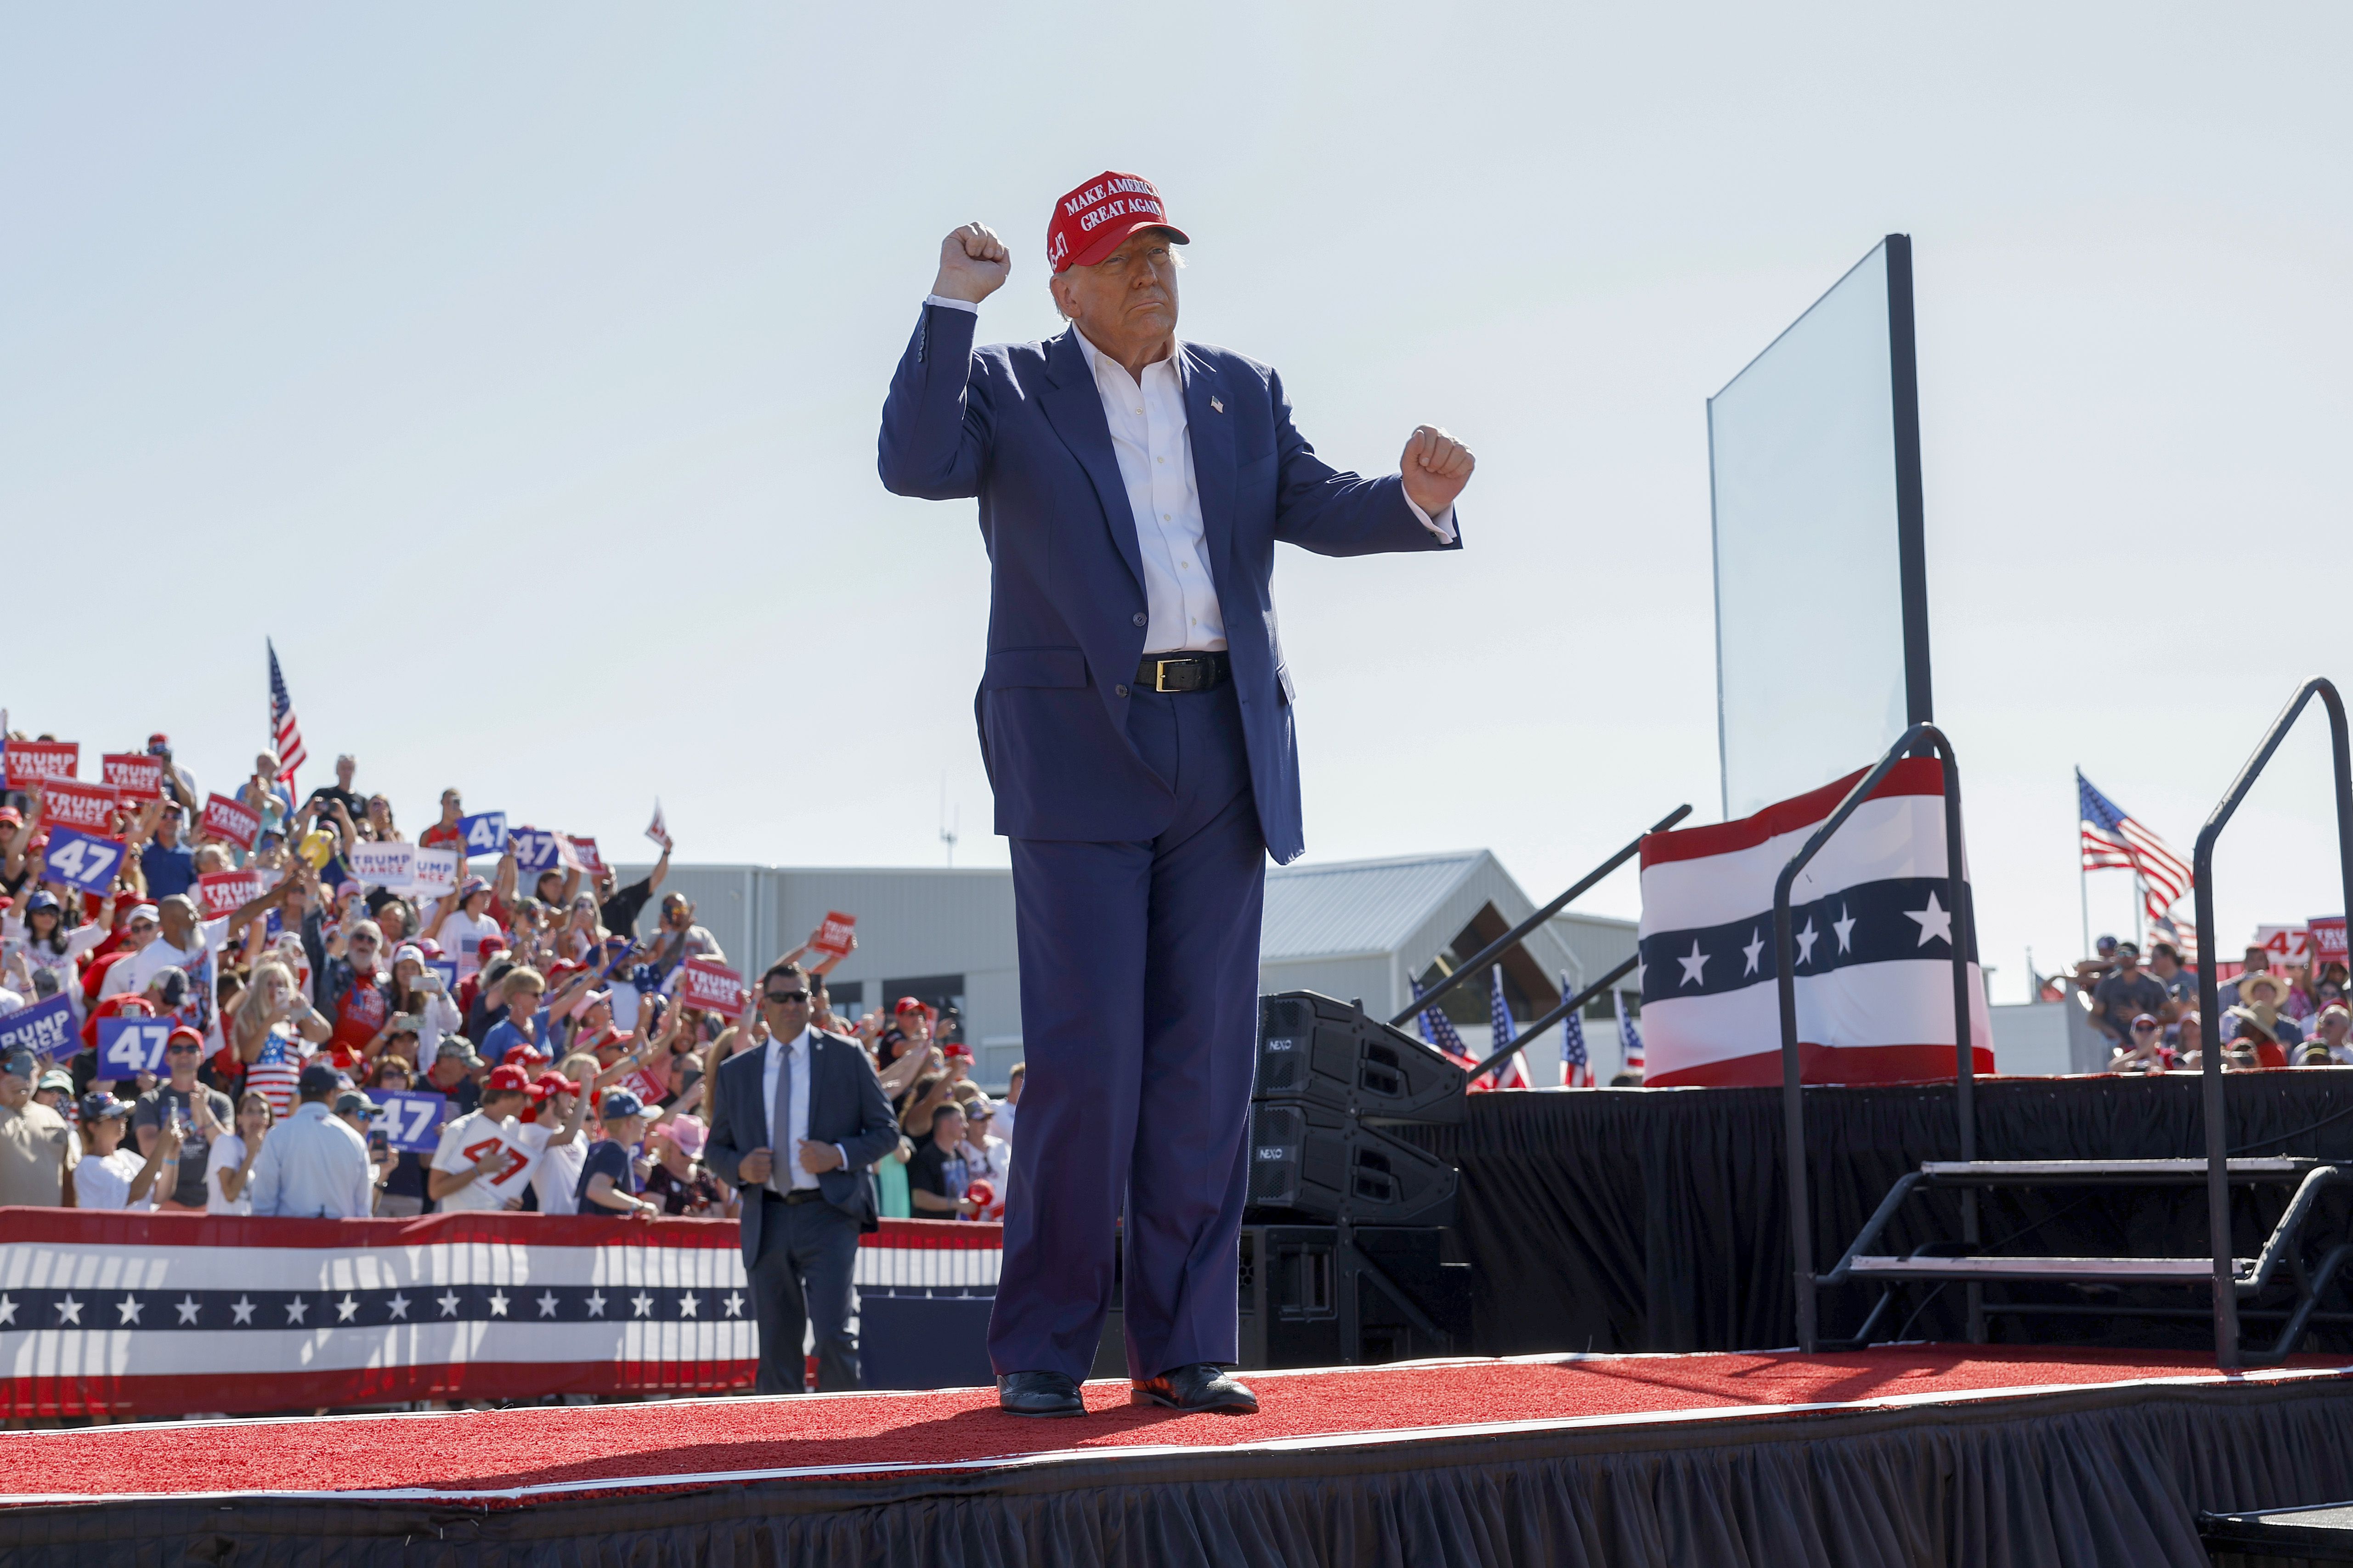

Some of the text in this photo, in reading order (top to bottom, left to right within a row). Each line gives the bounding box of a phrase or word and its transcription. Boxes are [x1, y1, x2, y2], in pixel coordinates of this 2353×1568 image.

[1064, 178, 1160, 216] MAKE AMERICA
[1080, 198, 1163, 231] GREAT AGAIN
[8, 751, 76, 766] TRUMP
[14, 763, 67, 775] VANCE
[106, 762, 161, 778] TRUMP
[112, 774, 155, 789] VANCE
[46, 791, 114, 812] TRUMP
[50, 805, 107, 823] VANCE
[209, 801, 258, 831] TRUMP
[211, 811, 252, 840] VANCE
[468, 816, 505, 848] 47
[354, 854, 411, 865] TRUMP
[515, 834, 556, 866] 47
[49, 839, 118, 884] 47
[360, 864, 404, 873] VANCE
[417, 861, 452, 873] UMP
[419, 872, 445, 881] NCE
[2266, 932, 2308, 955] 47
[2315, 928, 2347, 942] TRU
[687, 968, 742, 991] TRUMP
[0, 1010, 69, 1049] RUMP
[107, 1026, 170, 1071] 47
[1269, 1039, 1291, 1051] NEXO
[368, 1098, 436, 1143] 47
[1260, 1148, 1282, 1159] NEXO
